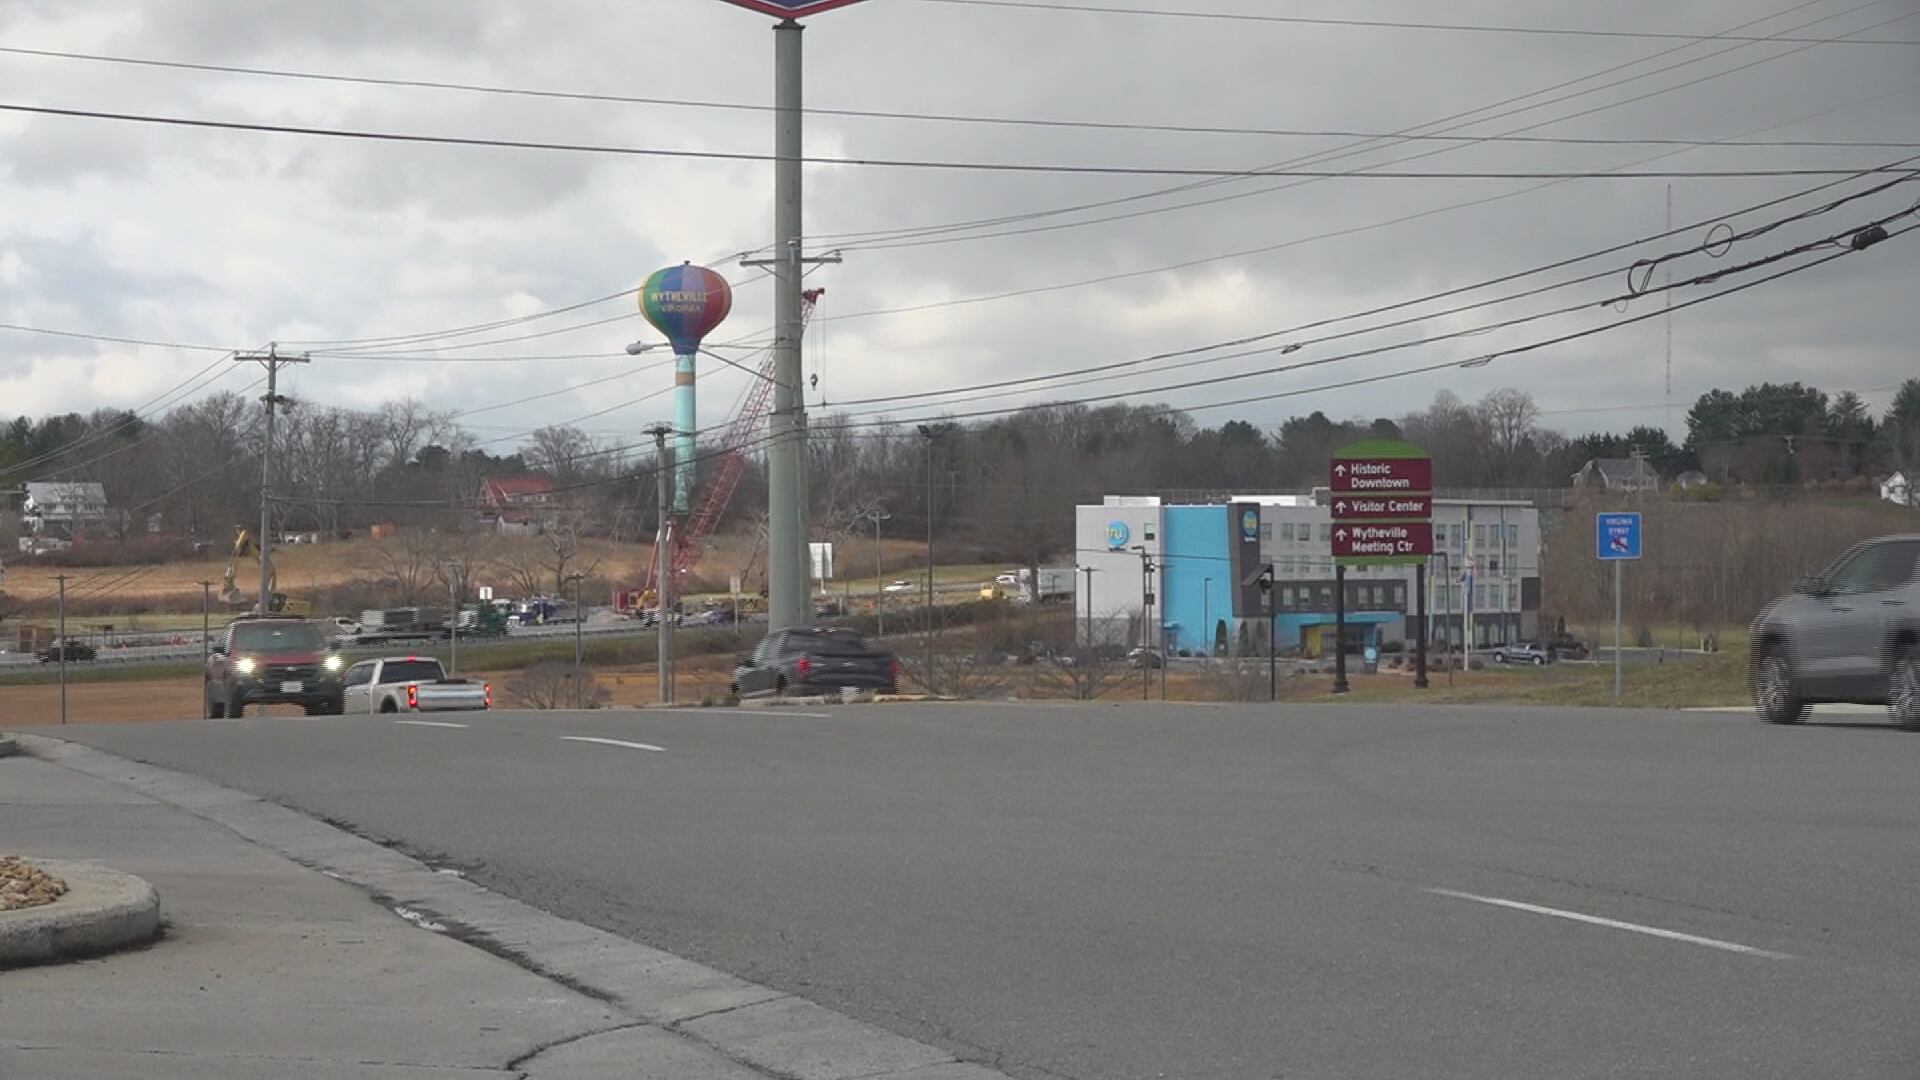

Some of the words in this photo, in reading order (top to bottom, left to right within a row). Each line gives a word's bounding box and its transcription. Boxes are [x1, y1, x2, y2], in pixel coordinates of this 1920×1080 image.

[1351, 463, 1391, 474] Historic
[1351, 477, 1409, 488] Downtown
[1352, 501, 1385, 511] Visitor
[1388, 501, 1424, 511] Center
[1352, 527, 1408, 540] Wytheville
[1352, 541, 1393, 555] Meeting
[1397, 541, 1414, 552] Ctr
